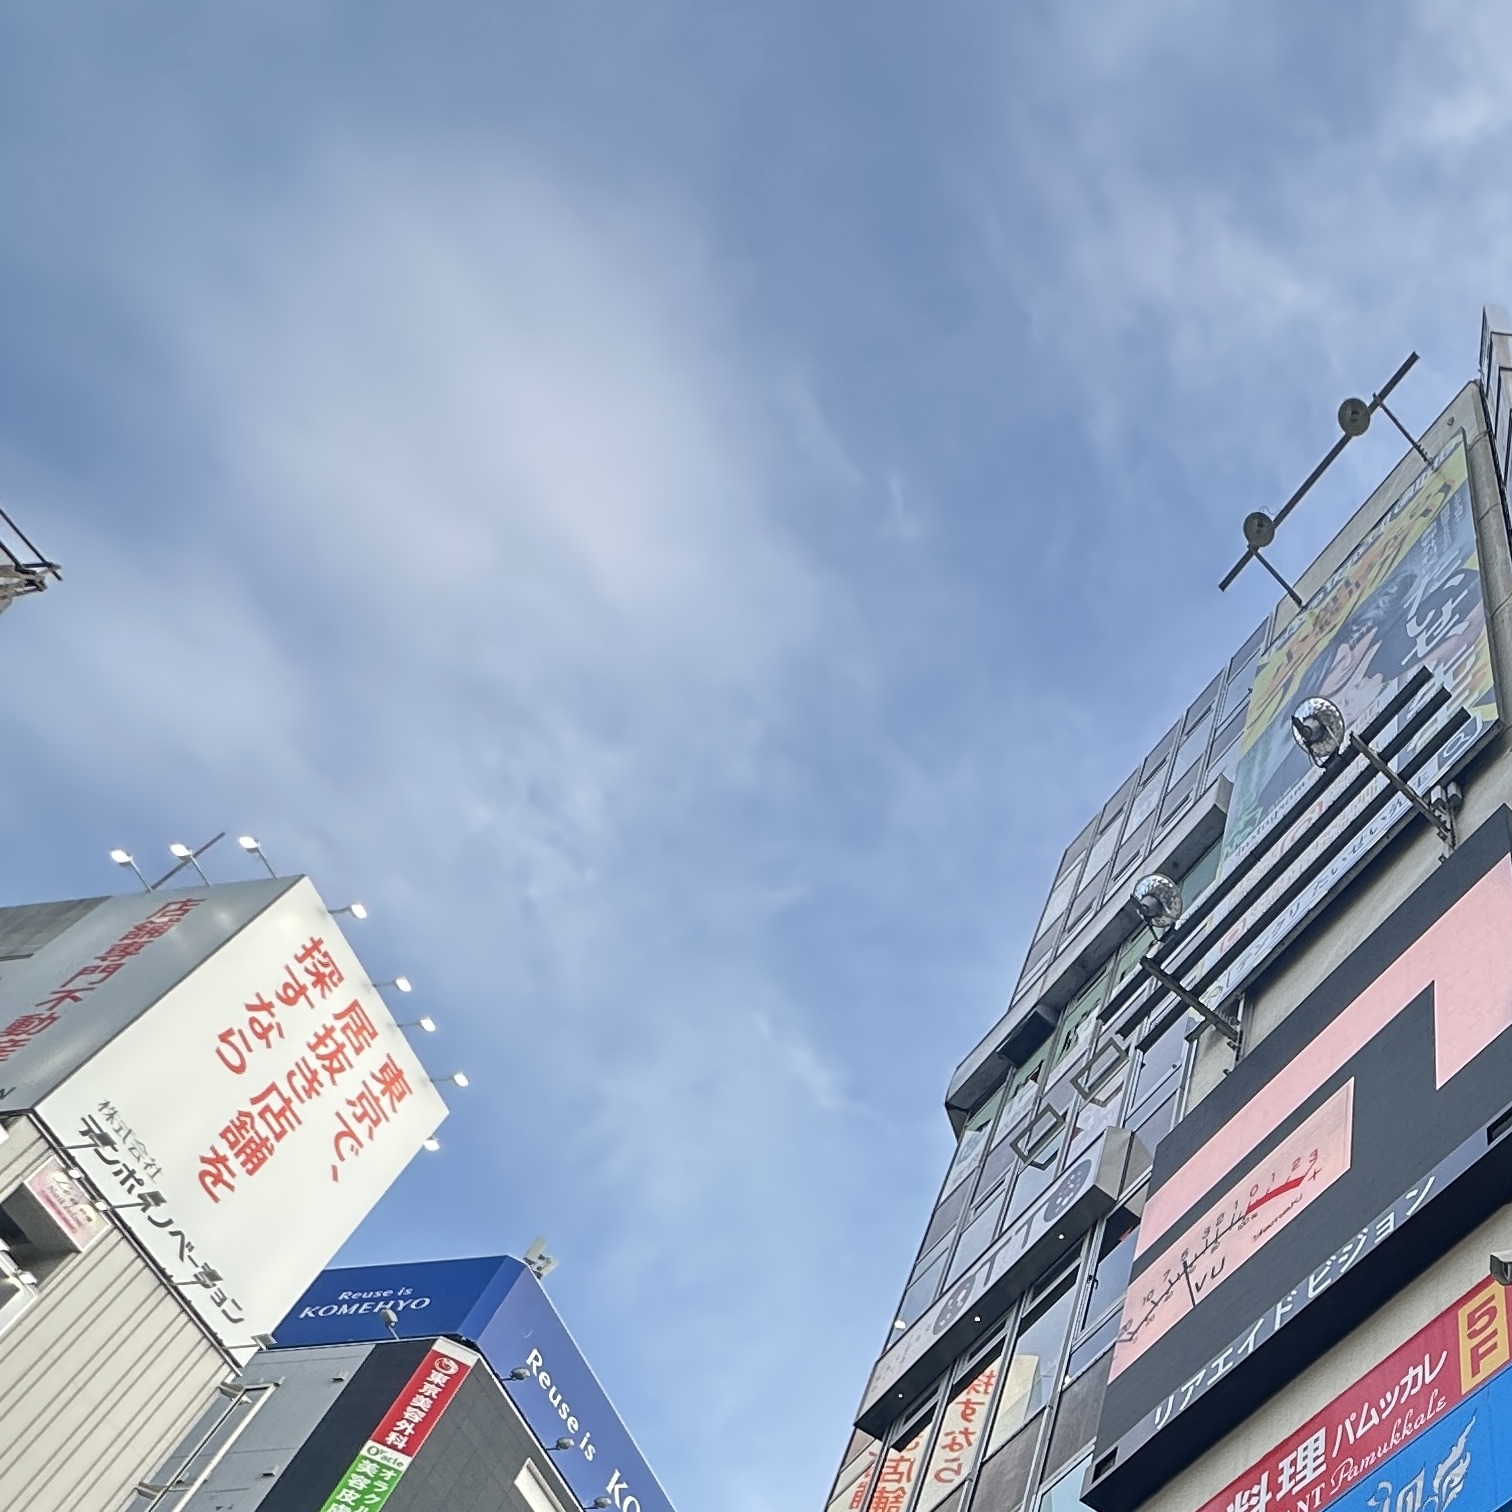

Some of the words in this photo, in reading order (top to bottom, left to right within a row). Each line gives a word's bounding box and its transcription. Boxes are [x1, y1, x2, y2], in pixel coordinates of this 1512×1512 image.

[214, 935, 346, 1075] 探すなら
[98, 1099, 163, 1184] 株式会社
[198, 999, 379, 1204] 居抜き店舗を
[299, 1297, 430, 1318] KOMEHYO
[338, 1289, 393, 1300] Reuse
[397, 1287, 413, 1297] is
[1153, 1175, 1436, 1430] リアエイドビジョン
[385, 1369, 451, 1450] 東京美容外科
[526, 1348, 579, 1434] Reuse
[579, 1431, 596, 1461] is
[1332, 1350, 1448, 1457] パムッカレ
[1467, 1292, 1502, 1381] 5F
[1330, 1394, 1449, 1496] Pamukkale
